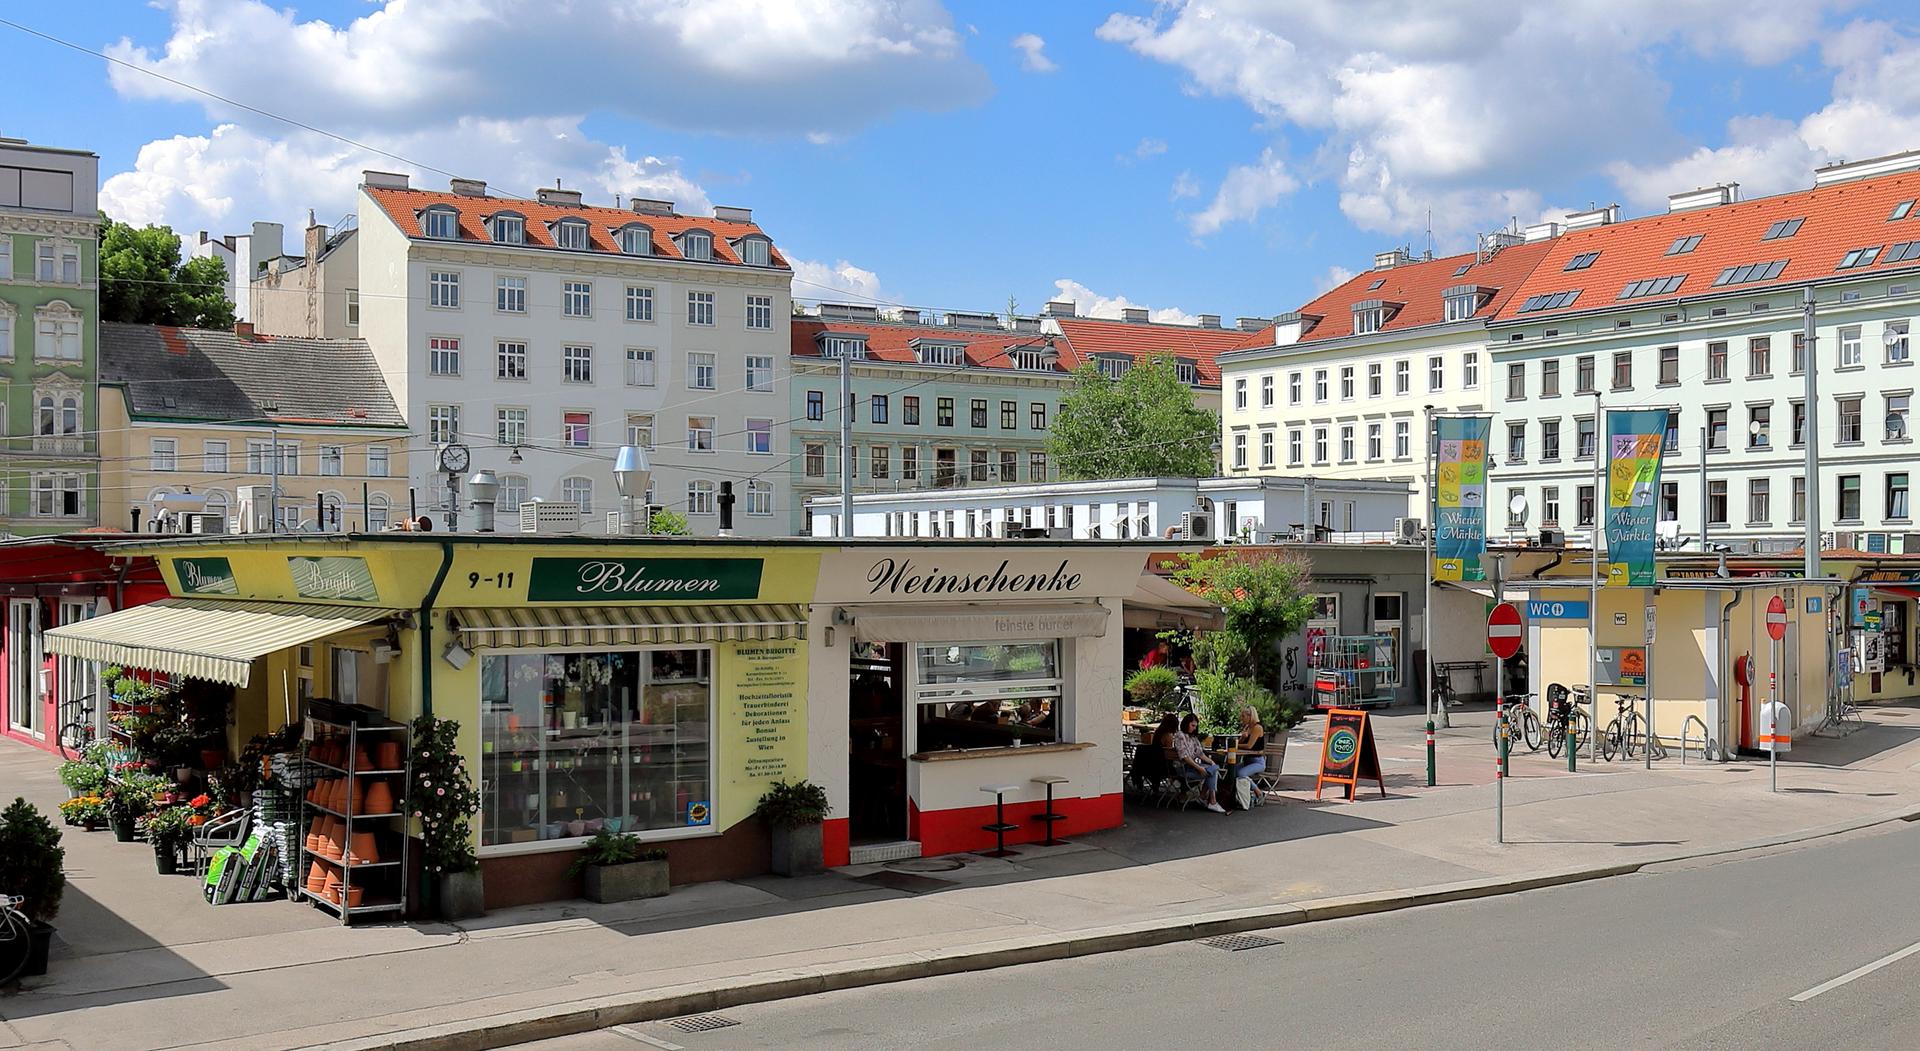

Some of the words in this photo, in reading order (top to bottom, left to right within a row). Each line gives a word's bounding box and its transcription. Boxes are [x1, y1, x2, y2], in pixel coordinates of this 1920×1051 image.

[1440, 512, 1482, 525] Wiener
[1440, 527, 1482, 541] Märkte
[183, 560, 225, 588] Blumen
[303, 559, 358, 598] Brigitte
[577, 561, 721, 593] Blumen
[866, 557, 1082, 595] Weinschenke
[1531, 603, 1550, 616] WC
[995, 618, 1034, 633] feinste
[1616, 615, 1627, 623] WC
[737, 648, 764, 656] BLUMEN
[766, 647, 795, 655] BRIGITTE
[739, 693, 792, 701] Hochzeitsfloristik
[743, 701, 789, 709] Trauerbinderei
